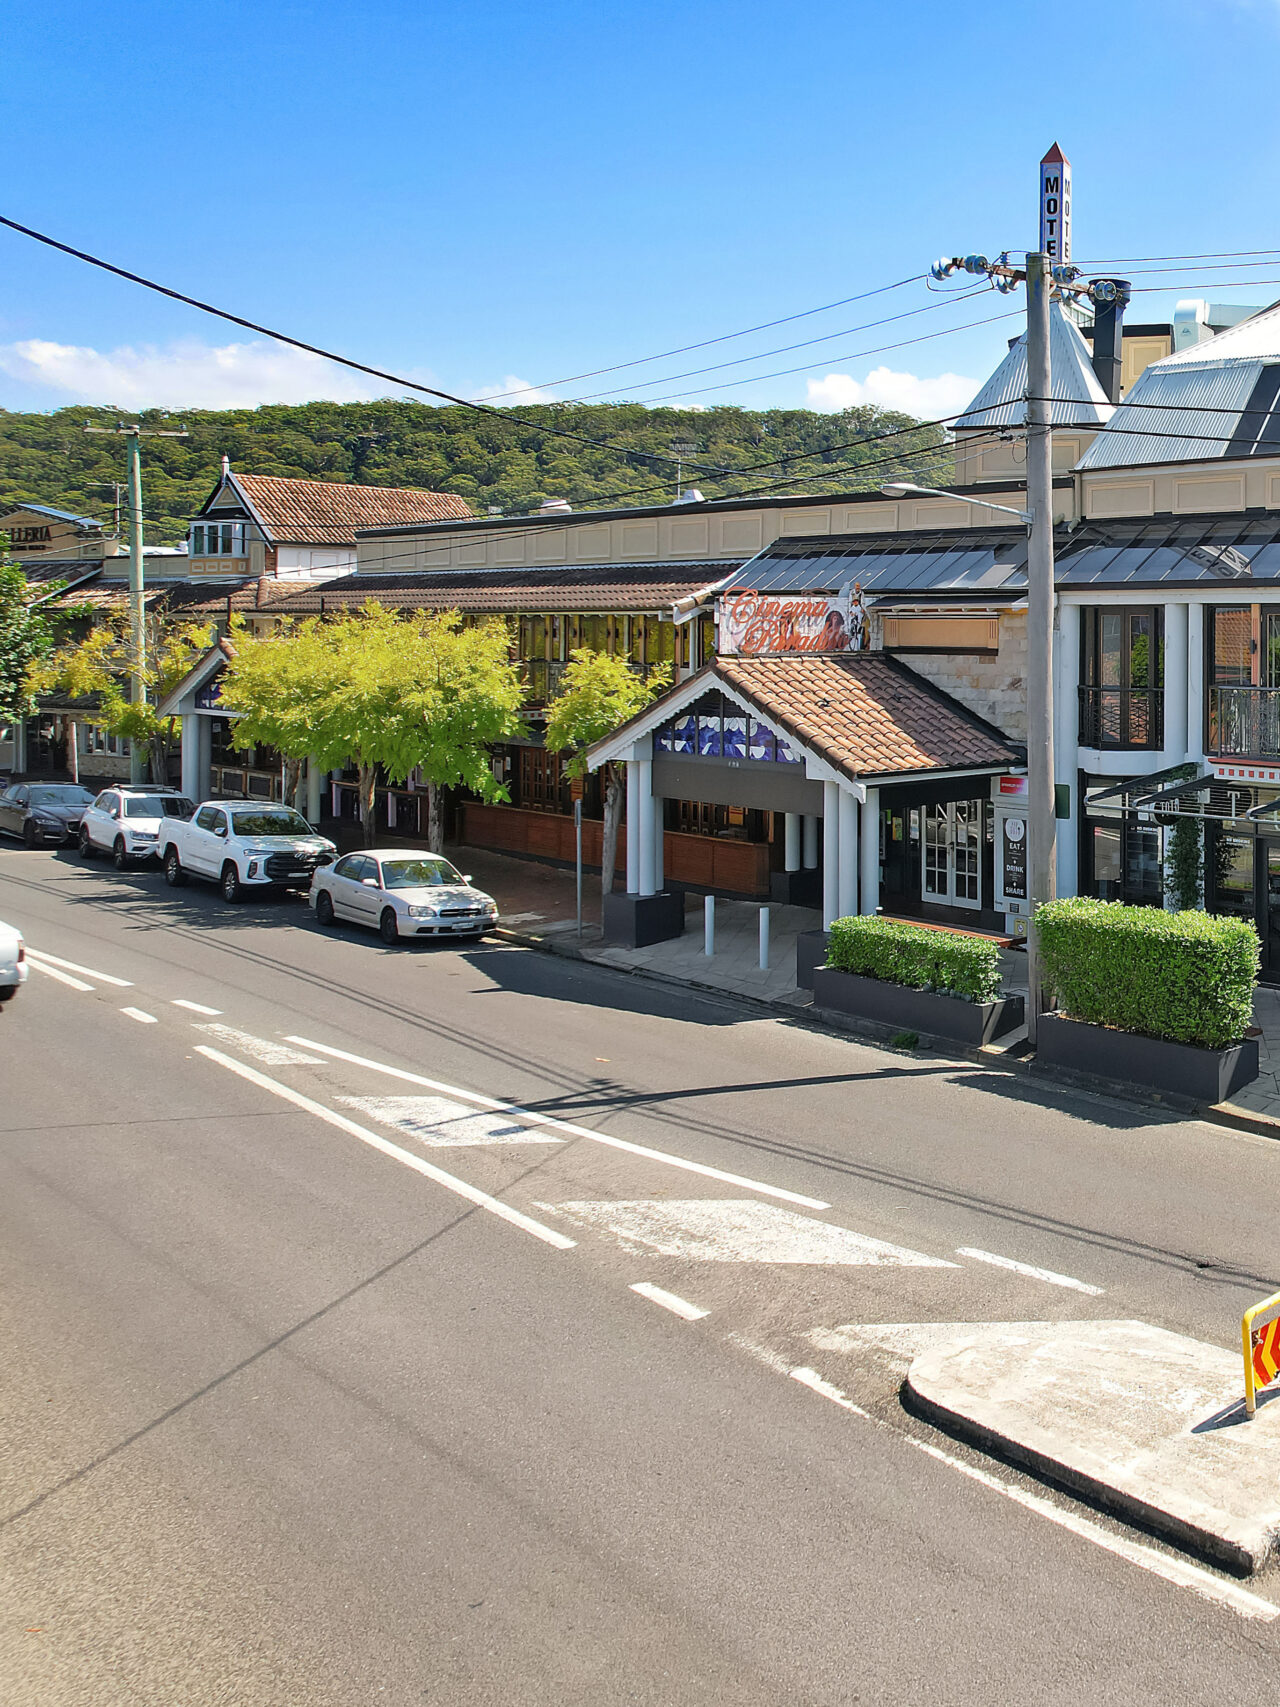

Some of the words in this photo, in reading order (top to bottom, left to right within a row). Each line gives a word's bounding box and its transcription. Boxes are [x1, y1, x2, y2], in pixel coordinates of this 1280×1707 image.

[3, 526, 52, 541] LLERIA
[724, 586, 829, 624] Cinema
[1009, 842, 1021, 850] EAT
[1006, 864, 1024, 874] DRINK
[1005, 886, 1025, 896] SHARE
